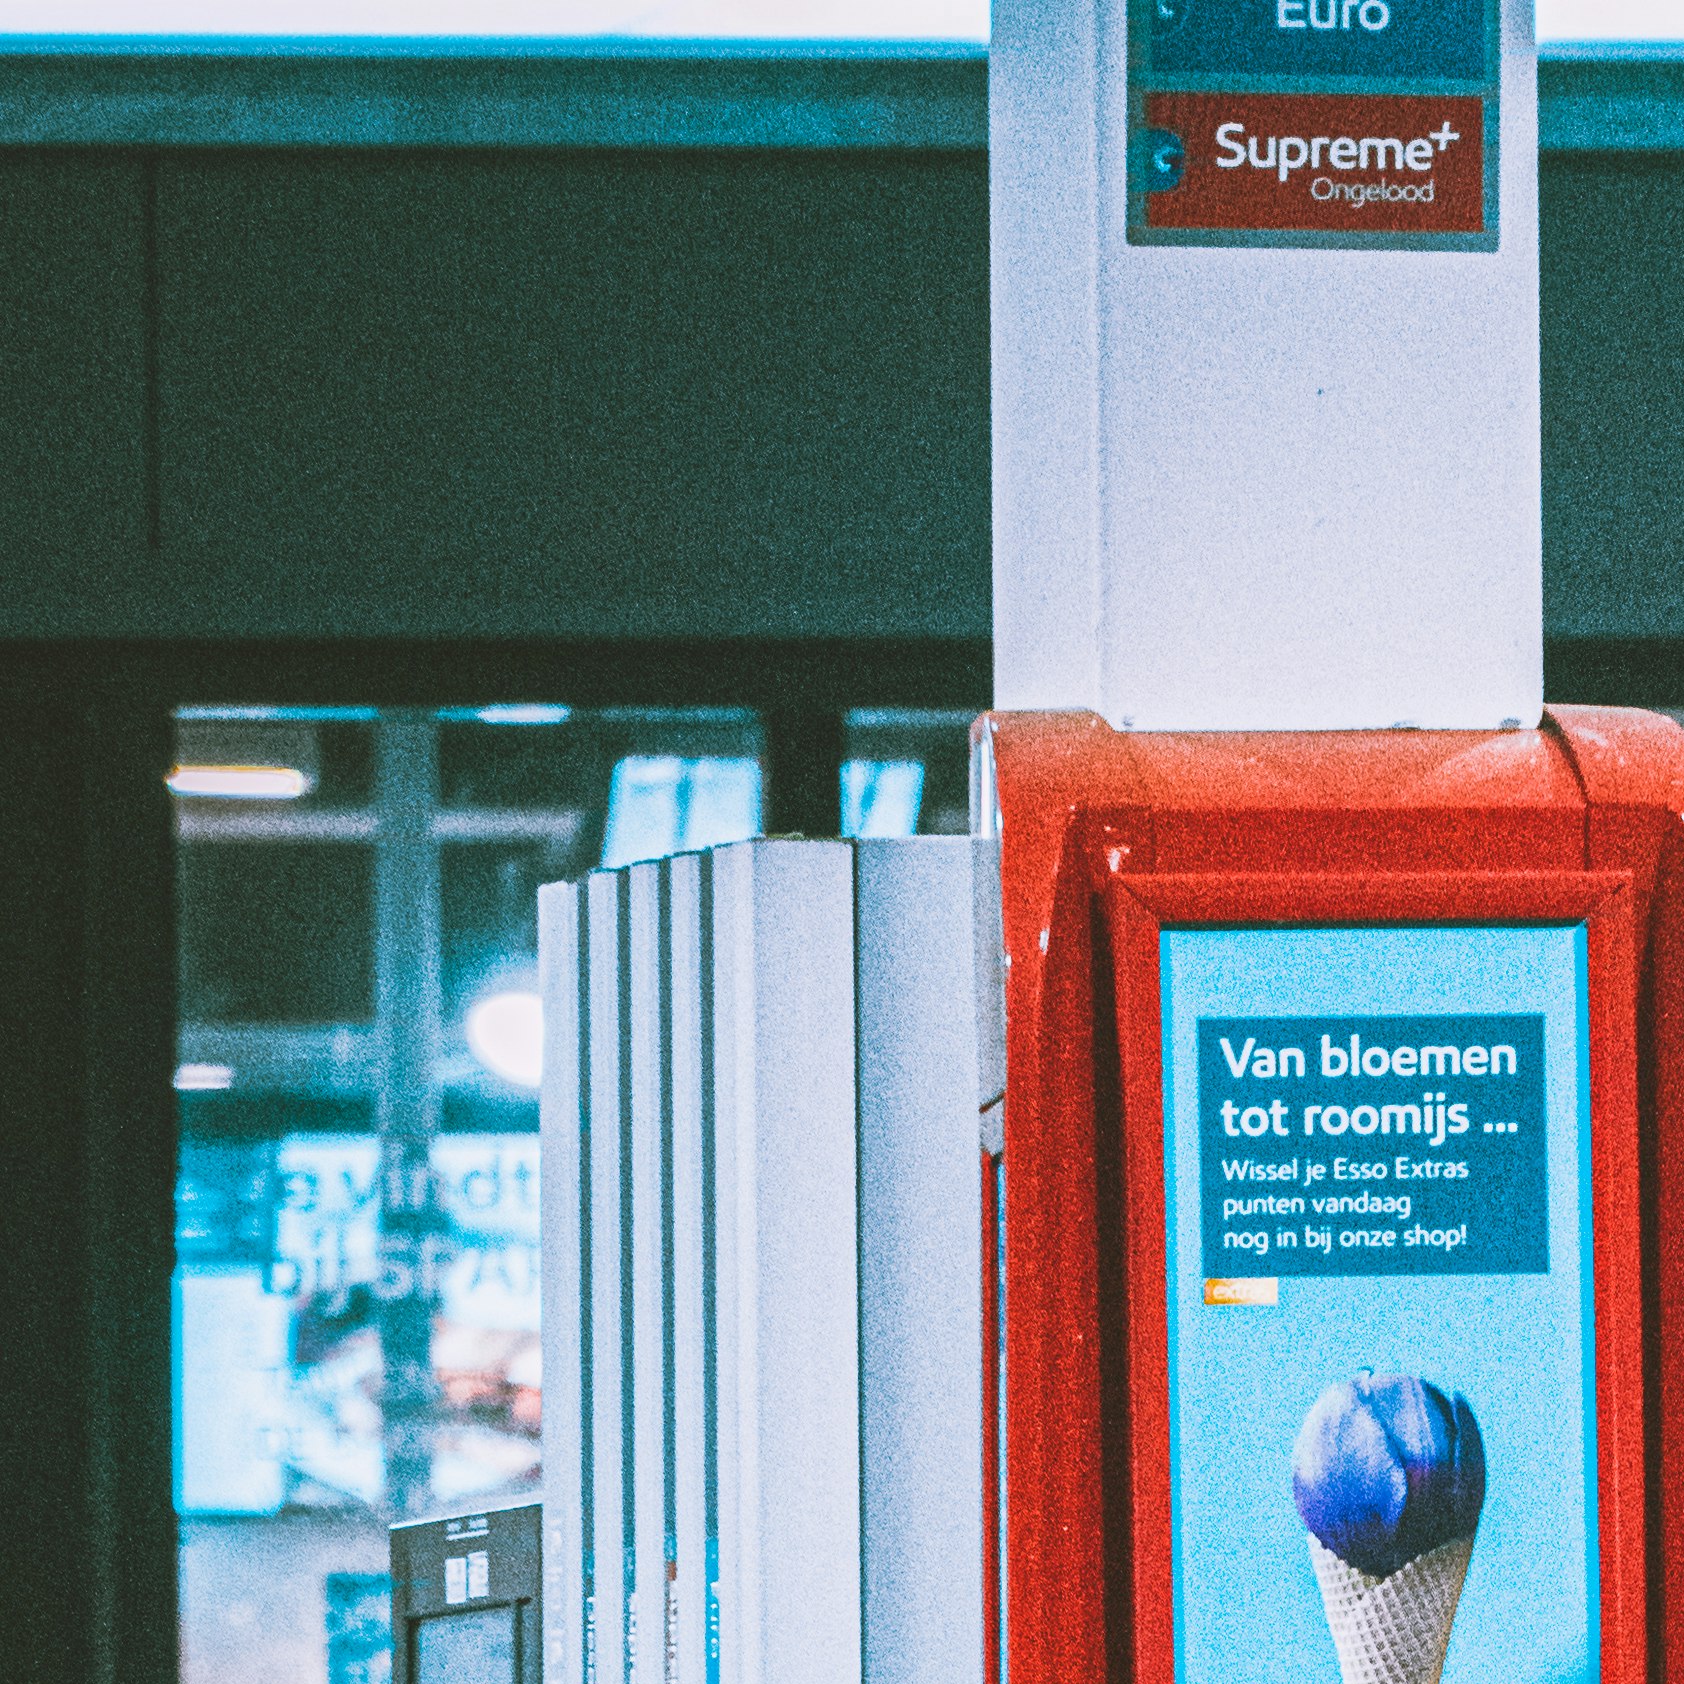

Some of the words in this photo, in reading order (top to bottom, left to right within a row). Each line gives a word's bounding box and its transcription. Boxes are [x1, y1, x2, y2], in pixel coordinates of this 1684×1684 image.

[1277, 0, 1390, 30] Euro
[1310, 176, 1436, 208] Ongelood
[1220, 1036, 1305, 1078] Van
[1320, 1034, 1517, 1077] bloemen
[1220, 1099, 1289, 1137] tot
[1304, 1092, 1470, 1147] roomijs
[1222, 1158, 1298, 1181] Wissel
[1303, 1158, 1327, 1186] je
[1333, 1158, 1388, 1180] Esso
[1396, 1157, 1469, 1179] Extras
[1223, 1195, 1305, 1221] punten
[1312, 1191, 1412, 1218] vandaag
[1223, 1229, 1269, 1255] nog
[1276, 1226, 1297, 1248] in
[1304, 1225, 1332, 1254] bij
[1339, 1228, 1396, 1248] onze
[1403, 1224, 1467, 1251] shop!
